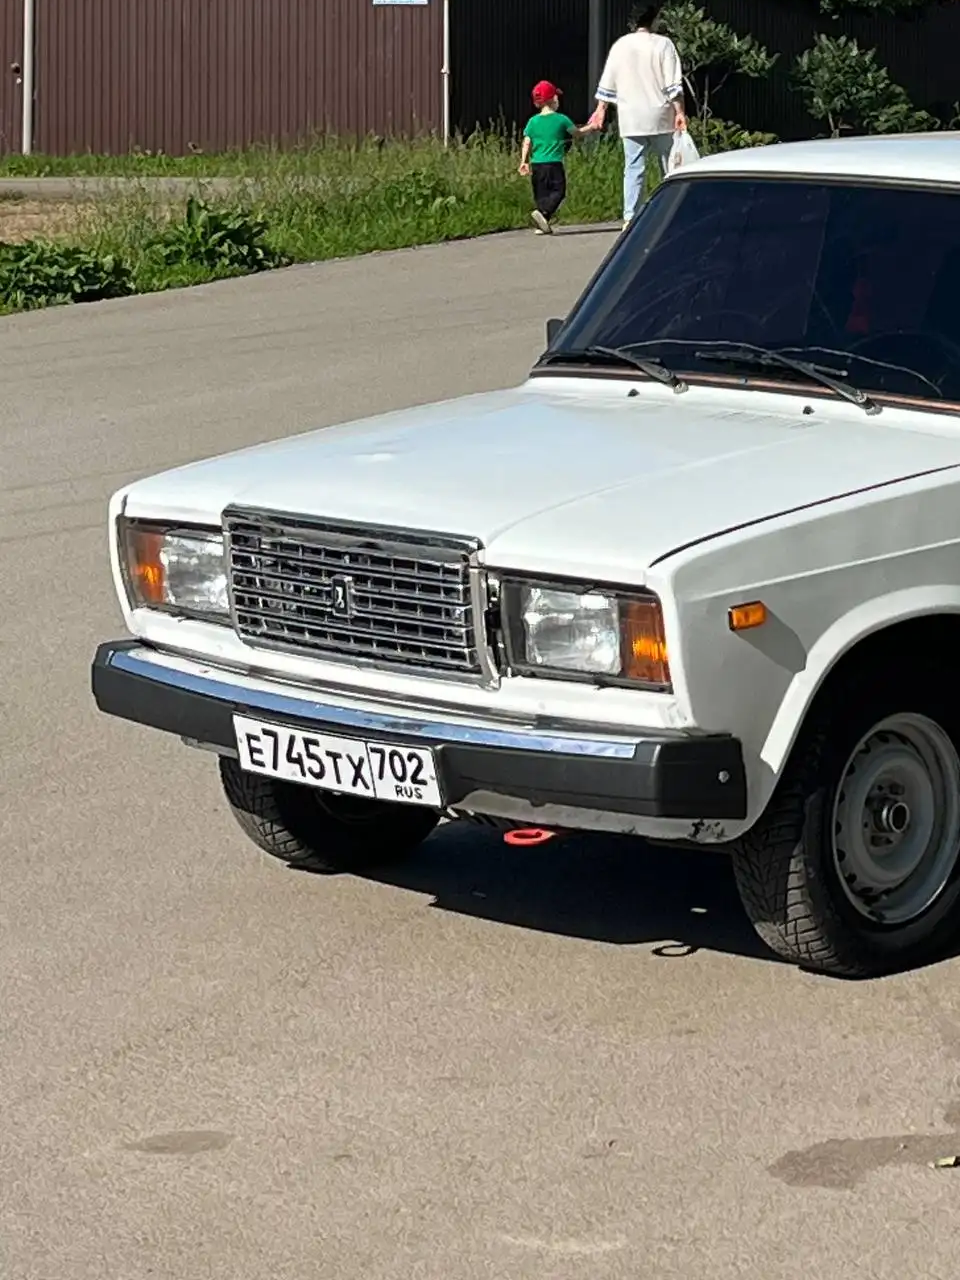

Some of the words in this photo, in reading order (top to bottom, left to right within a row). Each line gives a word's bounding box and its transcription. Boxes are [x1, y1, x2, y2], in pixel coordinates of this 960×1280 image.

[245, 728, 370, 790] Е745ТХ
[369, 747, 428, 786] 702
[394, 784, 423, 800] RUS
